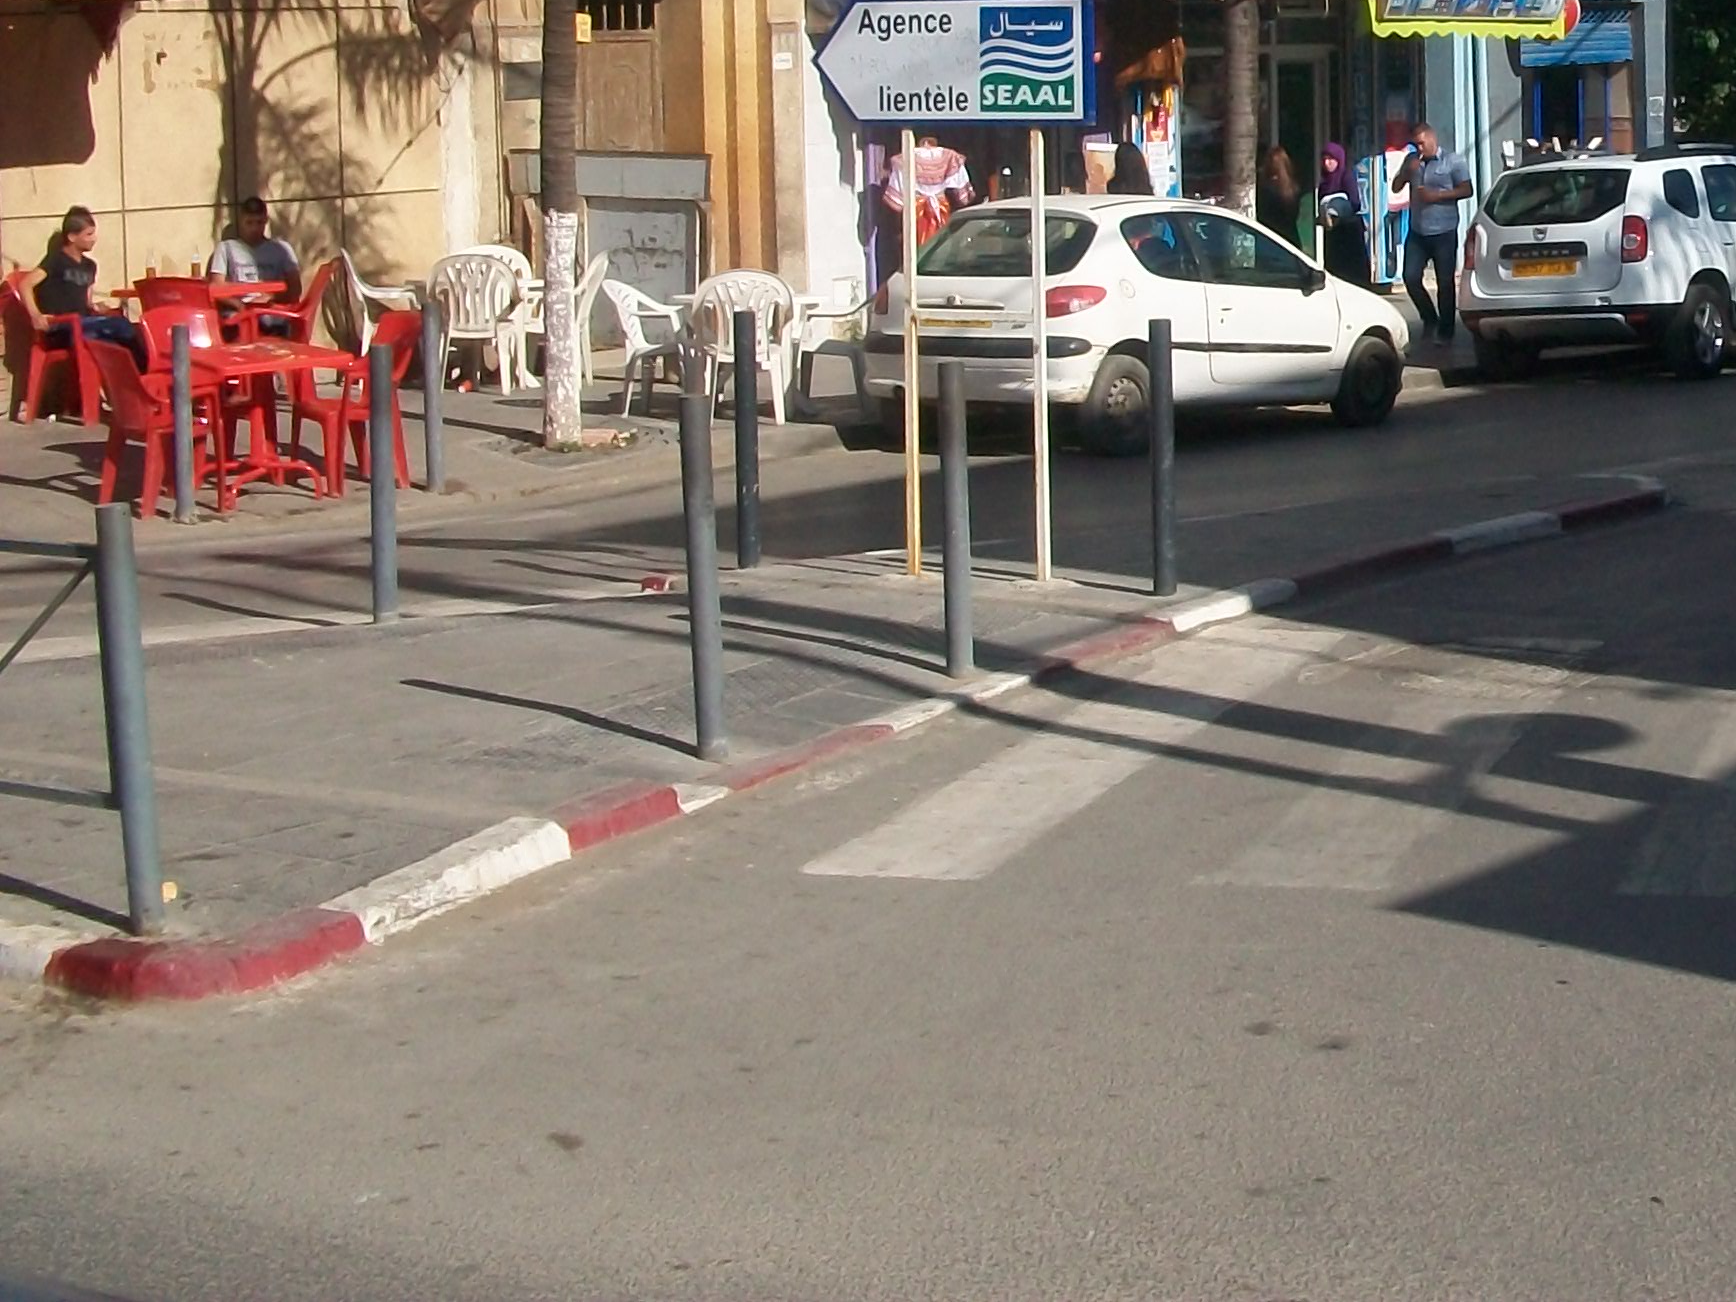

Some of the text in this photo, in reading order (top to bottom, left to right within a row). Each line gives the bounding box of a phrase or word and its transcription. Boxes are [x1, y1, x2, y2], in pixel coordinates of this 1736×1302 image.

[857, 8, 953, 42] Agence
[989, 11, 1064, 38] سيال
[878, 84, 970, 113] lientèle
[981, 83, 1073, 107] SEAAL
